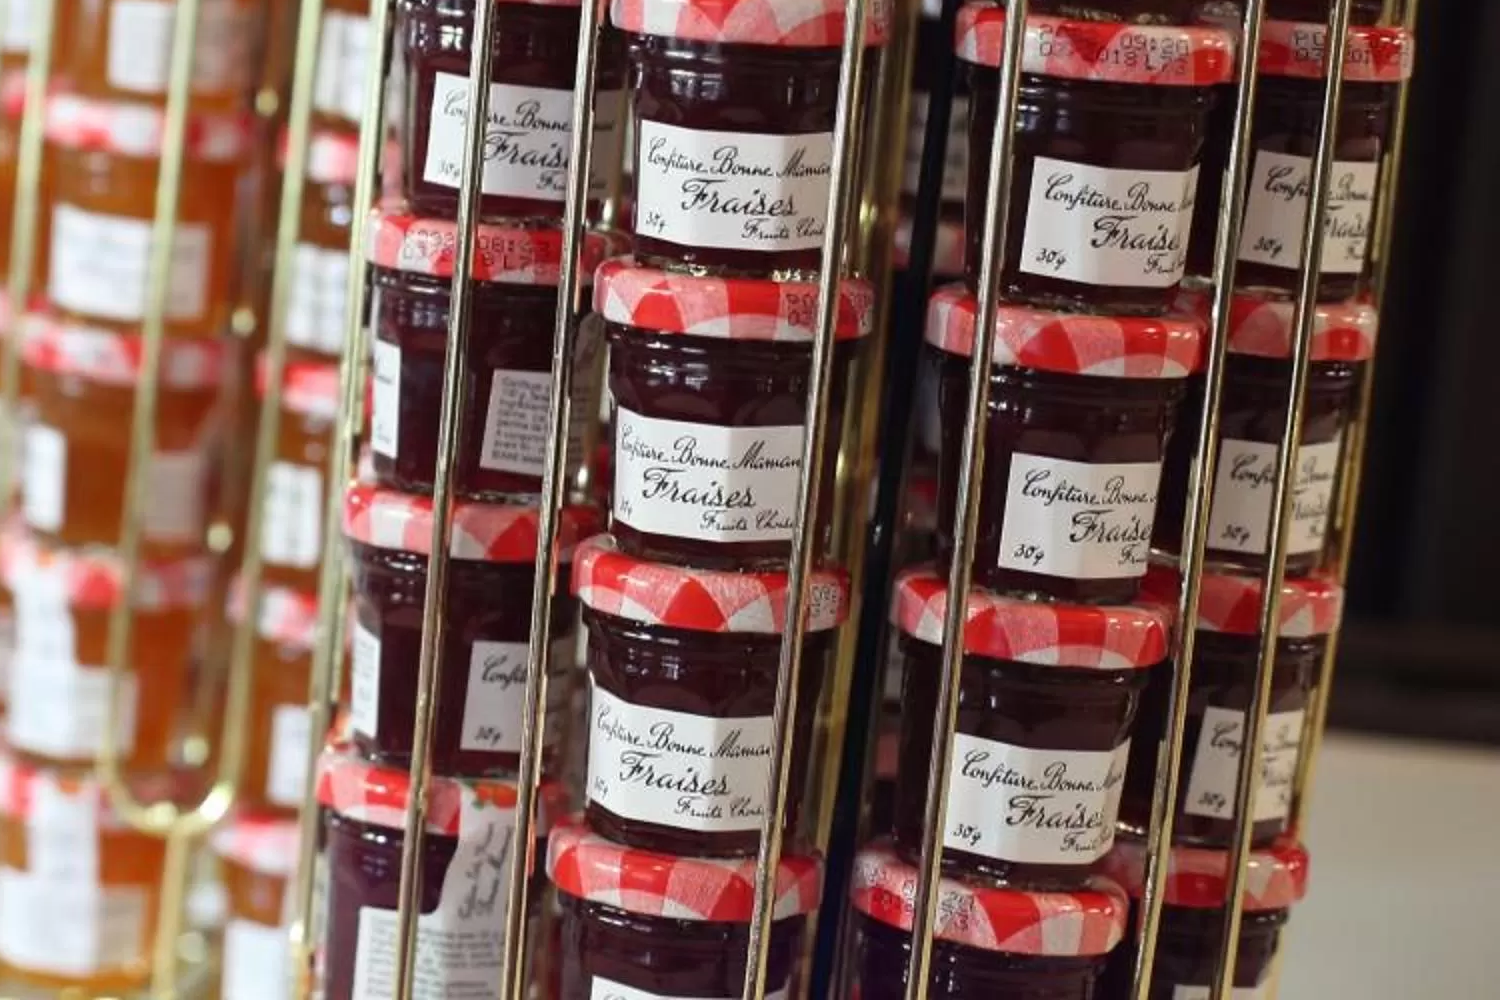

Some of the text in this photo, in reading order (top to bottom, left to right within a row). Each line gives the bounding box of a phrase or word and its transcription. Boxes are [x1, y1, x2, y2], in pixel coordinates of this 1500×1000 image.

[514, 99, 572, 133] Bonne
[709, 146, 773, 178] Bonne
[681, 177, 798, 218] Fraises
[1045, 172, 1122, 211] Confiture
[1124, 181, 1175, 213] Bonne
[1035, 248, 1066, 271] 30g
[671, 436, 730, 469] Bonne
[642, 467, 756, 508] Fraises
[1022, 468, 1149, 507] Confiture Bonne
[1069, 508, 1150, 544] Fraise
[1013, 543, 1045, 566] 30g
[647, 721, 705, 757] Bonne
[620, 750, 731, 796] Fraises
[961, 748, 1038, 788] Confiture
[1040, 761, 1095, 792] Bonne
[953, 823, 981, 847] 30g
